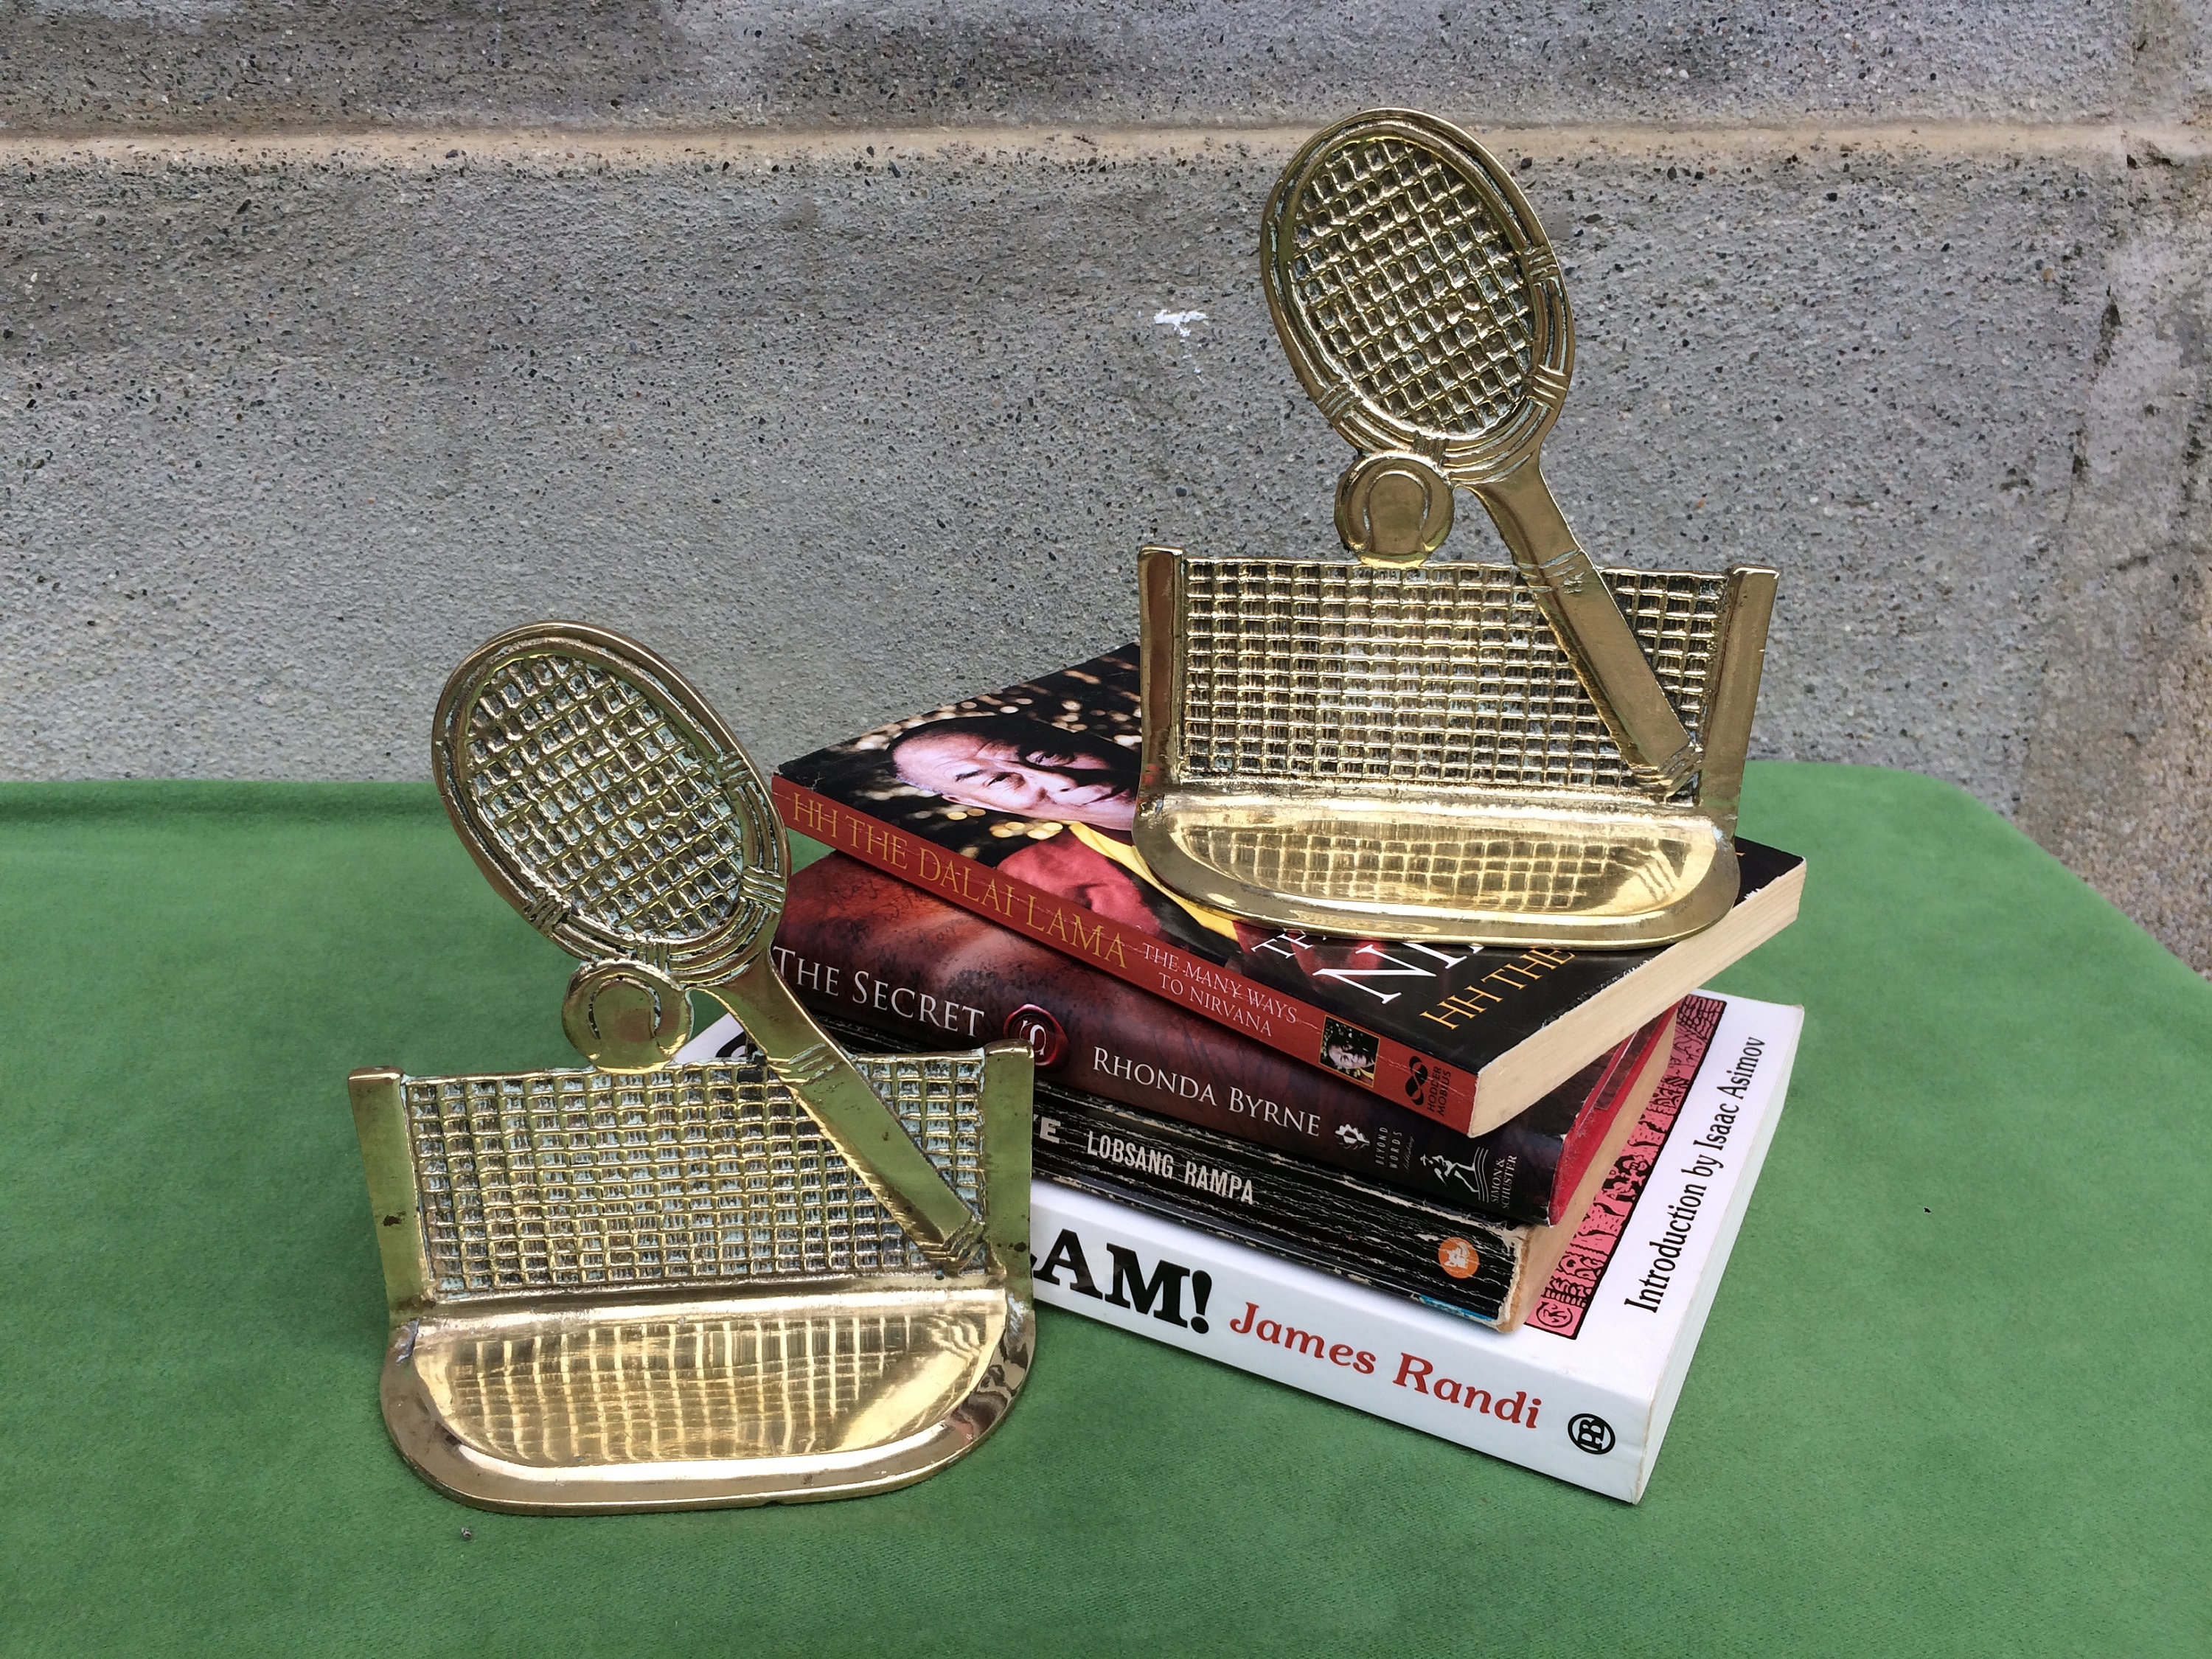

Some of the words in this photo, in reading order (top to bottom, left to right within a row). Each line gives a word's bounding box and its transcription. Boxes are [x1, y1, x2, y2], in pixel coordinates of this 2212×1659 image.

[793, 792, 838, 838] HH
[845, 815, 908, 870] THE
[919, 847, 1013, 917] DALAI
[1026, 894, 1127, 969] LAMA
[773, 945, 840, 996] THE
[852, 970, 985, 1037] SECRET
[1142, 942, 1178, 972] THE
[1183, 961, 1242, 998] MANY
[1247, 987, 1298, 1023] WAYS
[1158, 972, 1183, 995] TO
[1189, 986, 1273, 1037] NIRVANA
[1312, 942, 1484, 1004] NI
[1419, 985, 1503, 1030] HH
[1481, 949, 1576, 991] THE
[1093, 1046, 1217, 1106] RHONDA
[1228, 1086, 1321, 1137] BYRNE
[1427, 1066, 1442, 1112] HODDER
[1436, 1071, 1451, 1116] MOBIUS
[1717, 1036, 1766, 1100] Asimov
[1033, 1113, 1061, 1144] E
[1375, 1127, 1388, 1165] BEYOND
[1390, 1132, 1402, 1169] WORDS
[1693, 1102, 1739, 1151] Isaac
[1087, 1130, 1174, 1179] LOBSANG
[1184, 1161, 1253, 1205] RAMPA
[1490, 1168, 1502, 1203] SIMON
[1496, 1158, 1506, 1168] &
[1501, 1155, 1517, 1209] SCHUSTER
[1681, 1154, 1724, 1178] by
[1624, 1183, 1707, 1314] Introduction
[1031, 1228, 1213, 1335] AM!
[1230, 1301, 1377, 1374] James
[1392, 1352, 1542, 1429] Randi
